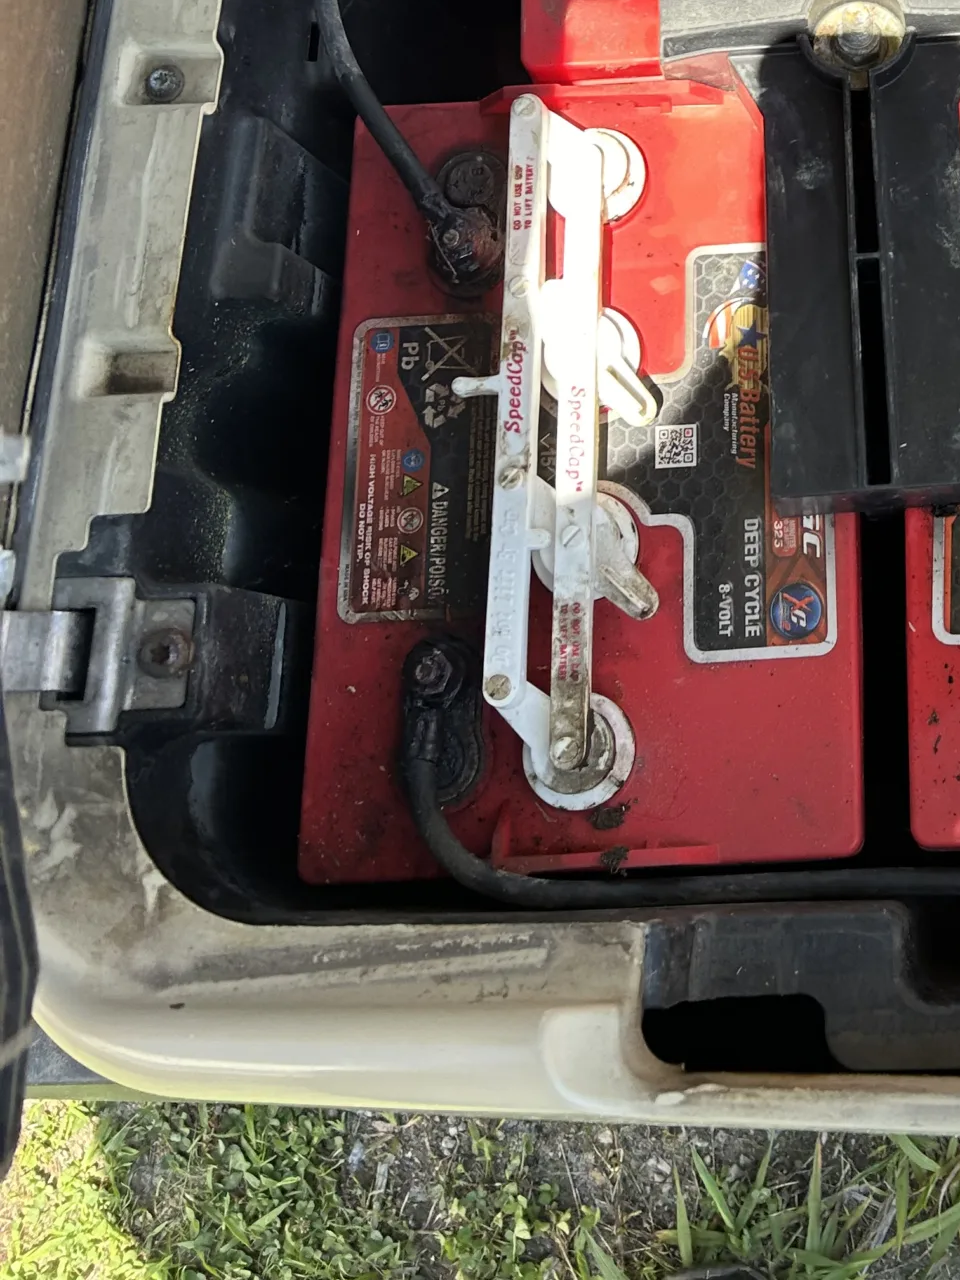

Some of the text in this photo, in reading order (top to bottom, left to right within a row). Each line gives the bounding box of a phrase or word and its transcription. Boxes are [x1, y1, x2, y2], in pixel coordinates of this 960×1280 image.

[514, 184, 522, 197] USE
[525, 164, 533, 195] BATTERY
[513, 203, 521, 216] NOT
[524, 199, 532, 216] LIFT
[401, 342, 420, 370] Pb
[437, 400, 447, 411] Pb
[723, 393, 731, 432] Company
[730, 392, 738, 455] Manufacturing
[735, 388, 761, 468] Battery
[358, 503, 366, 518] DO
[366, 481, 375, 523] VOLTAGE
[365, 526, 373, 550] RISK
[773, 520, 783, 548] 325
[356, 543, 364, 562] TIP.
[364, 552, 371, 567] OF
[361, 569, 371, 604] SHOCK
[744, 519, 760, 637] DEEP CYCLE
[719, 583, 732, 637] 8-VOLT
